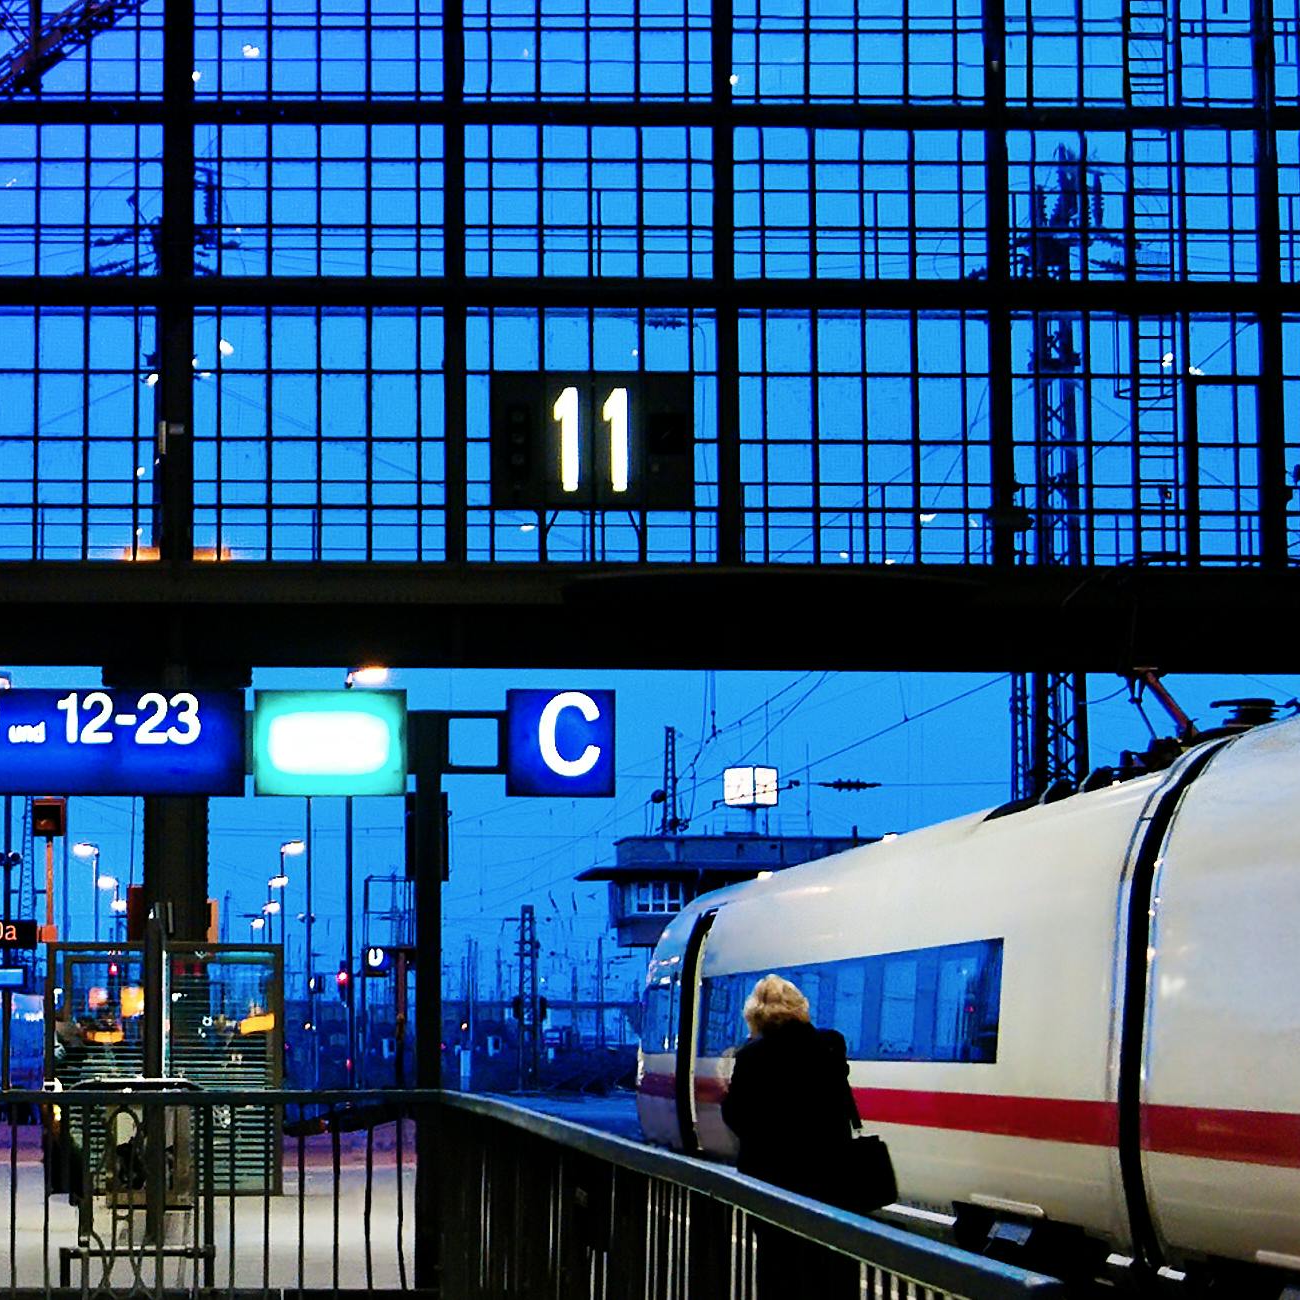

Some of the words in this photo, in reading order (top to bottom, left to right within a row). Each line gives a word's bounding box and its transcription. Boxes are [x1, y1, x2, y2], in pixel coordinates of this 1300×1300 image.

[554, 386, 629, 491] 11
[8, 721, 46, 743] und
[57, 692, 202, 745] 12-23
[538, 691, 600, 777] C
